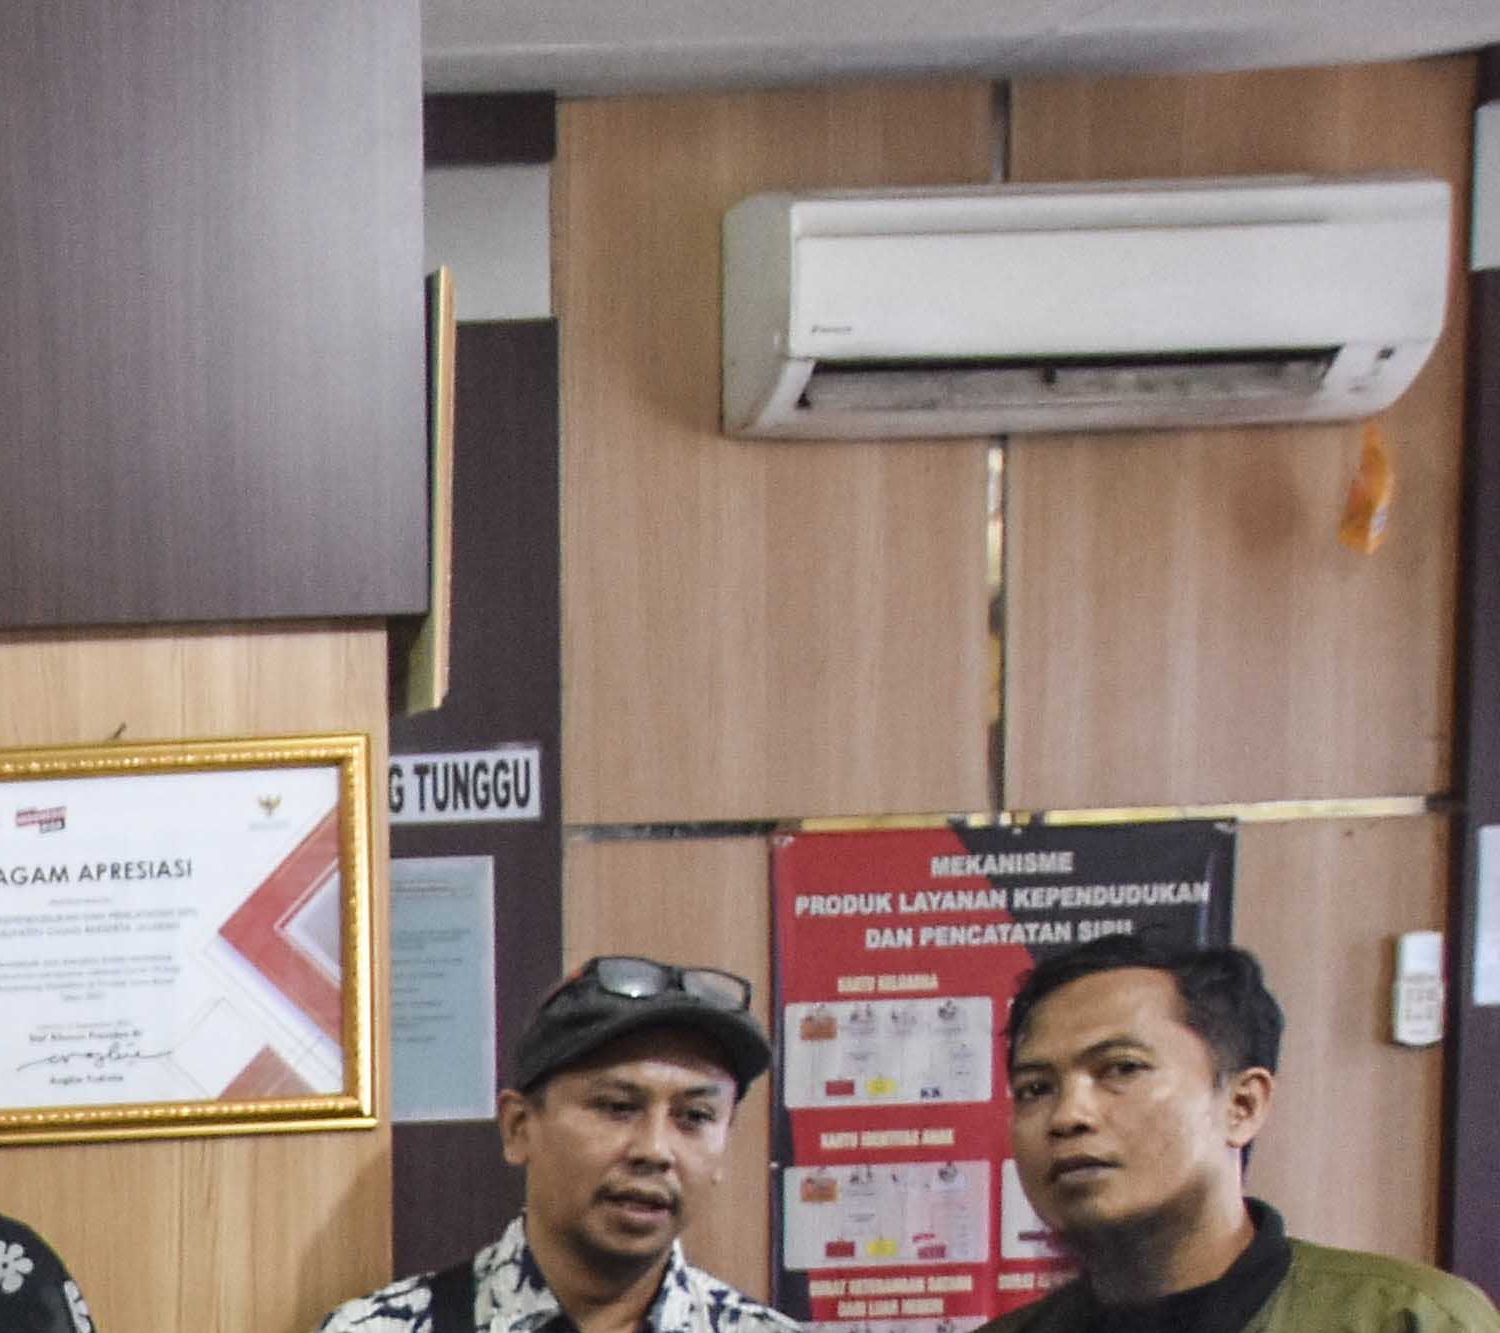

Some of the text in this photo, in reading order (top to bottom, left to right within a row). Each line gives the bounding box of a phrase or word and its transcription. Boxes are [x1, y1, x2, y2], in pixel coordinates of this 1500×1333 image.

[414, 758, 531, 812] TUNGGU
[78, 859, 192, 882] APRESIASI
[931, 851, 1073, 876] MEKANISME
[795, 882, 1210, 915] PRODUK LAYANAN KEPENDUDUKAN
[865, 927, 912, 949] DAN
[921, 922, 1071, 946] PENCATATAN
